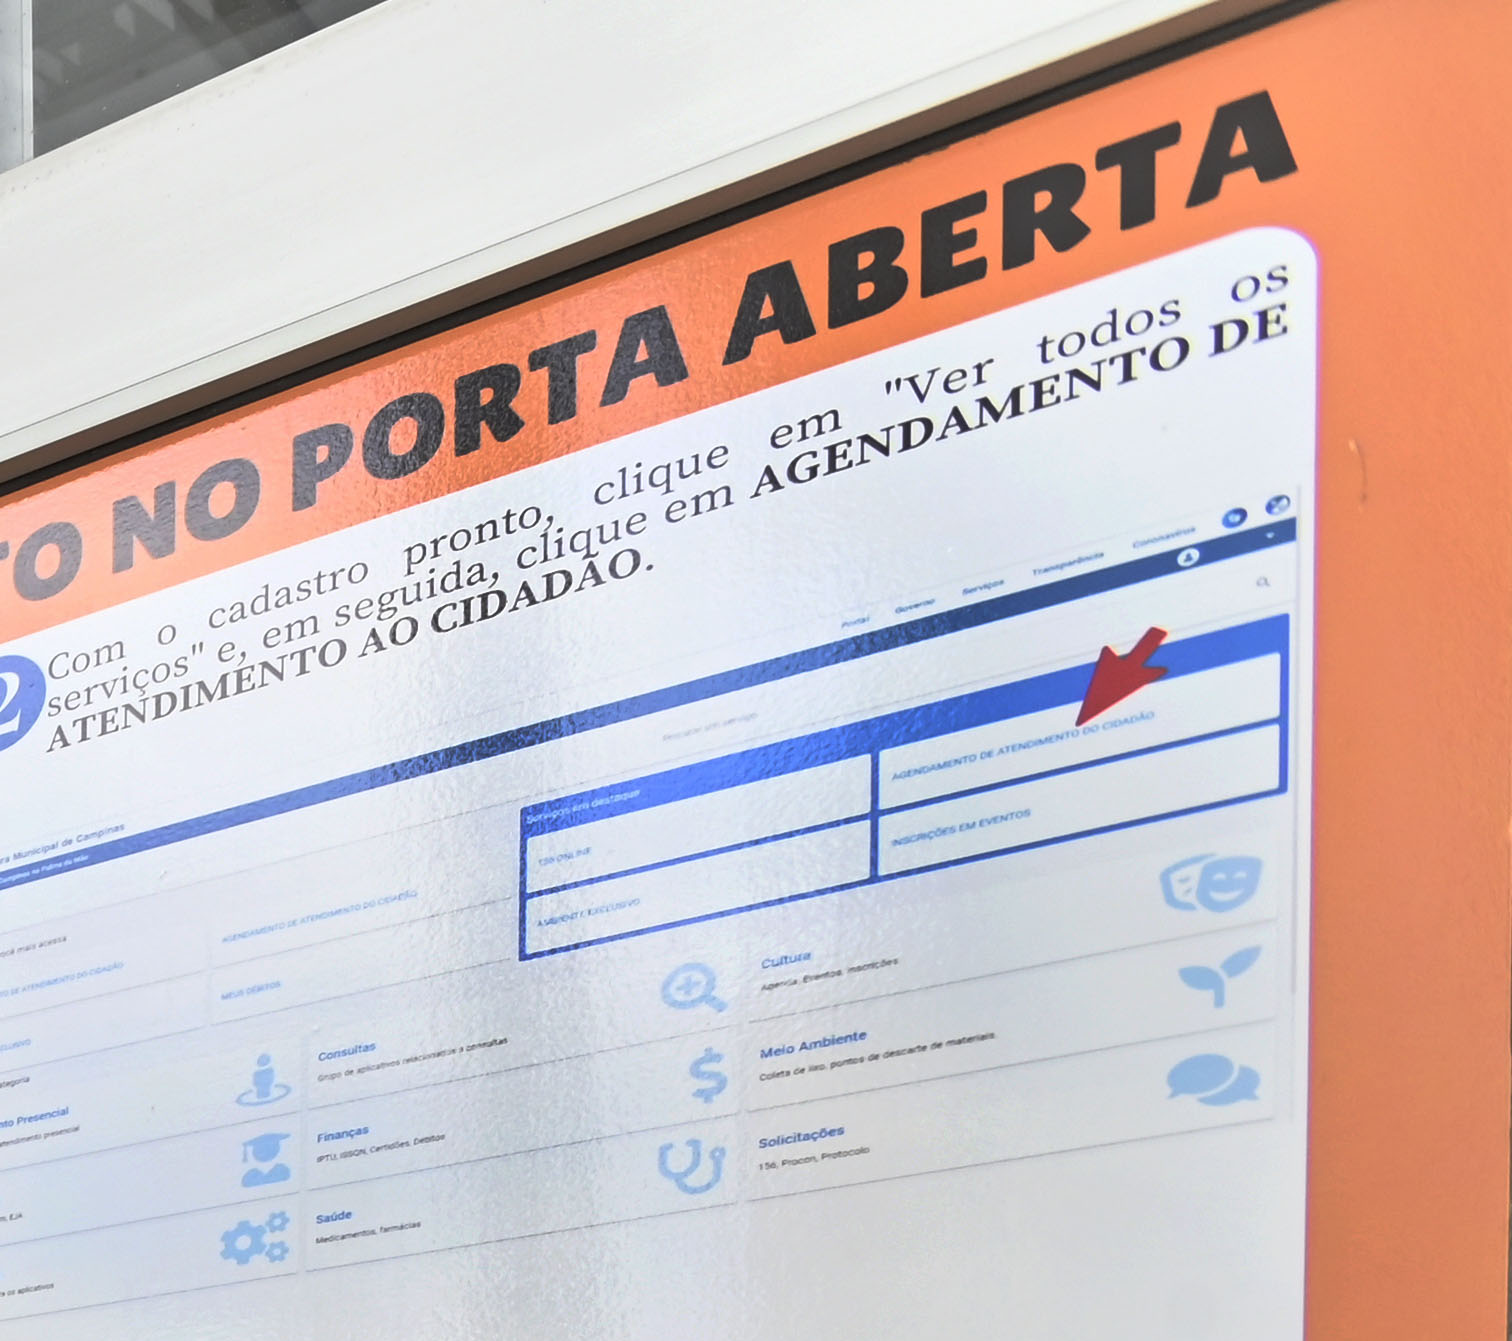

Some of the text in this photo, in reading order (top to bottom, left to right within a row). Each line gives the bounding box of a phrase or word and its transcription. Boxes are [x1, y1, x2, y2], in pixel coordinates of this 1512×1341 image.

[112, 458, 260, 574] NO
[292, 304, 689, 512] PORTA
[721, 90, 1298, 366] ABERTA
[47, 303, 1288, 718] serviços" e, em seguida, clique em AGENDAMENTO DE
[46, 548, 654, 753] ATENDIMENTO AO CIDADÃO.
[761, 952, 812, 970] Cultura
[318, 1043, 377, 1062] Consultas
[760, 1031, 868, 1059] Meio Ambiente
[316, 1210, 352, 1225] Saúde
